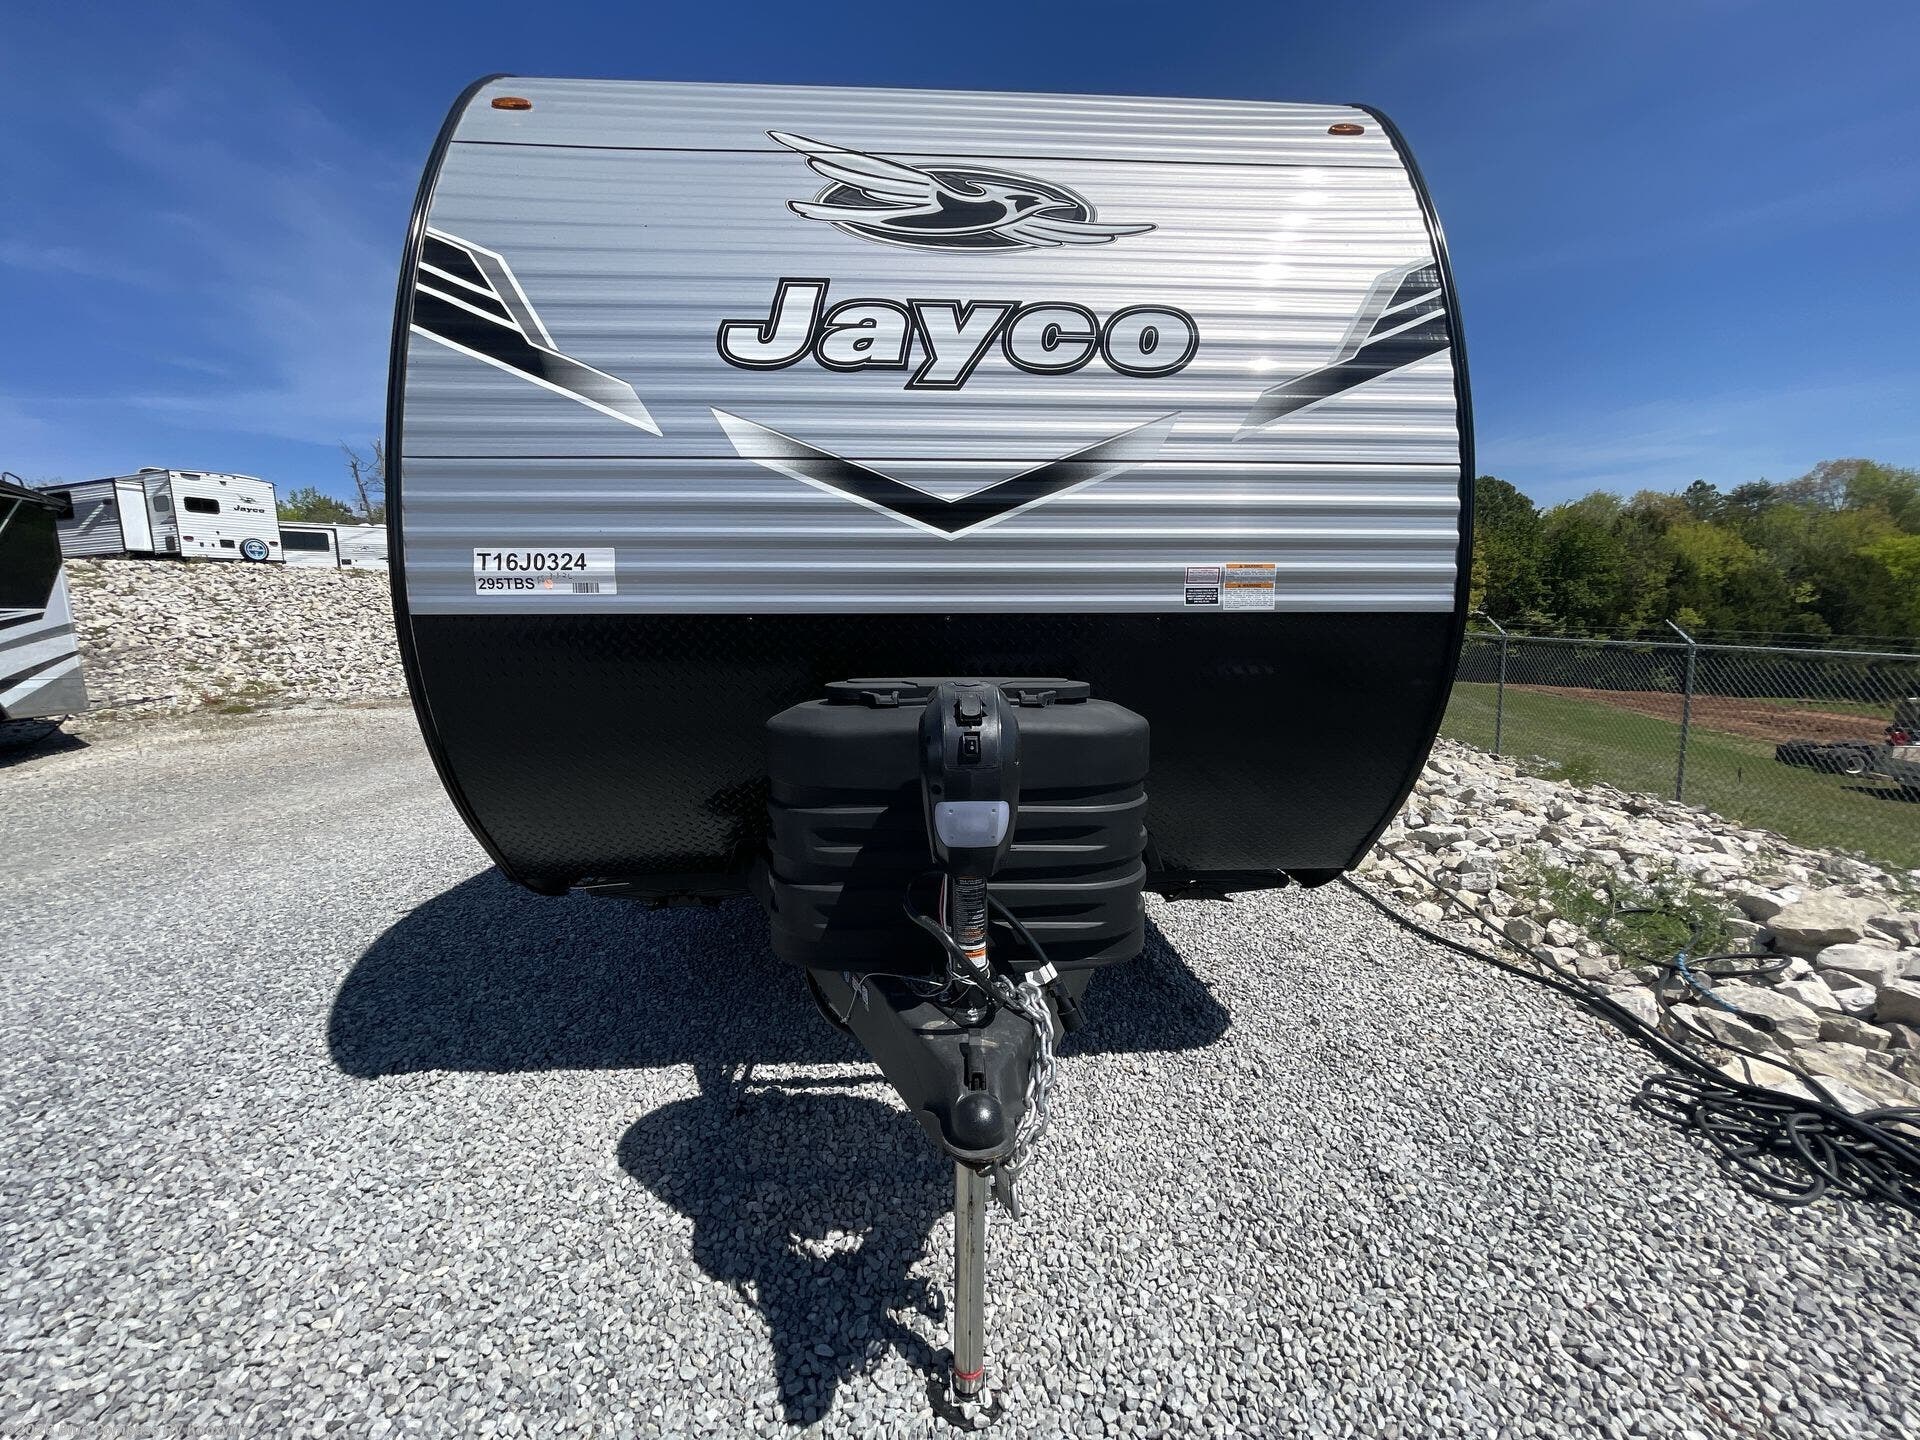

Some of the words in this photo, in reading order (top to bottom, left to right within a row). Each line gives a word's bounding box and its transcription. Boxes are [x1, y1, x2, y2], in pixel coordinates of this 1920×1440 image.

[716, 277, 1199, 391] Jayco
[233, 505, 265, 514] Jayco
[476, 552, 587, 571] T16J0324
[478, 577, 535, 590] 295TBS
